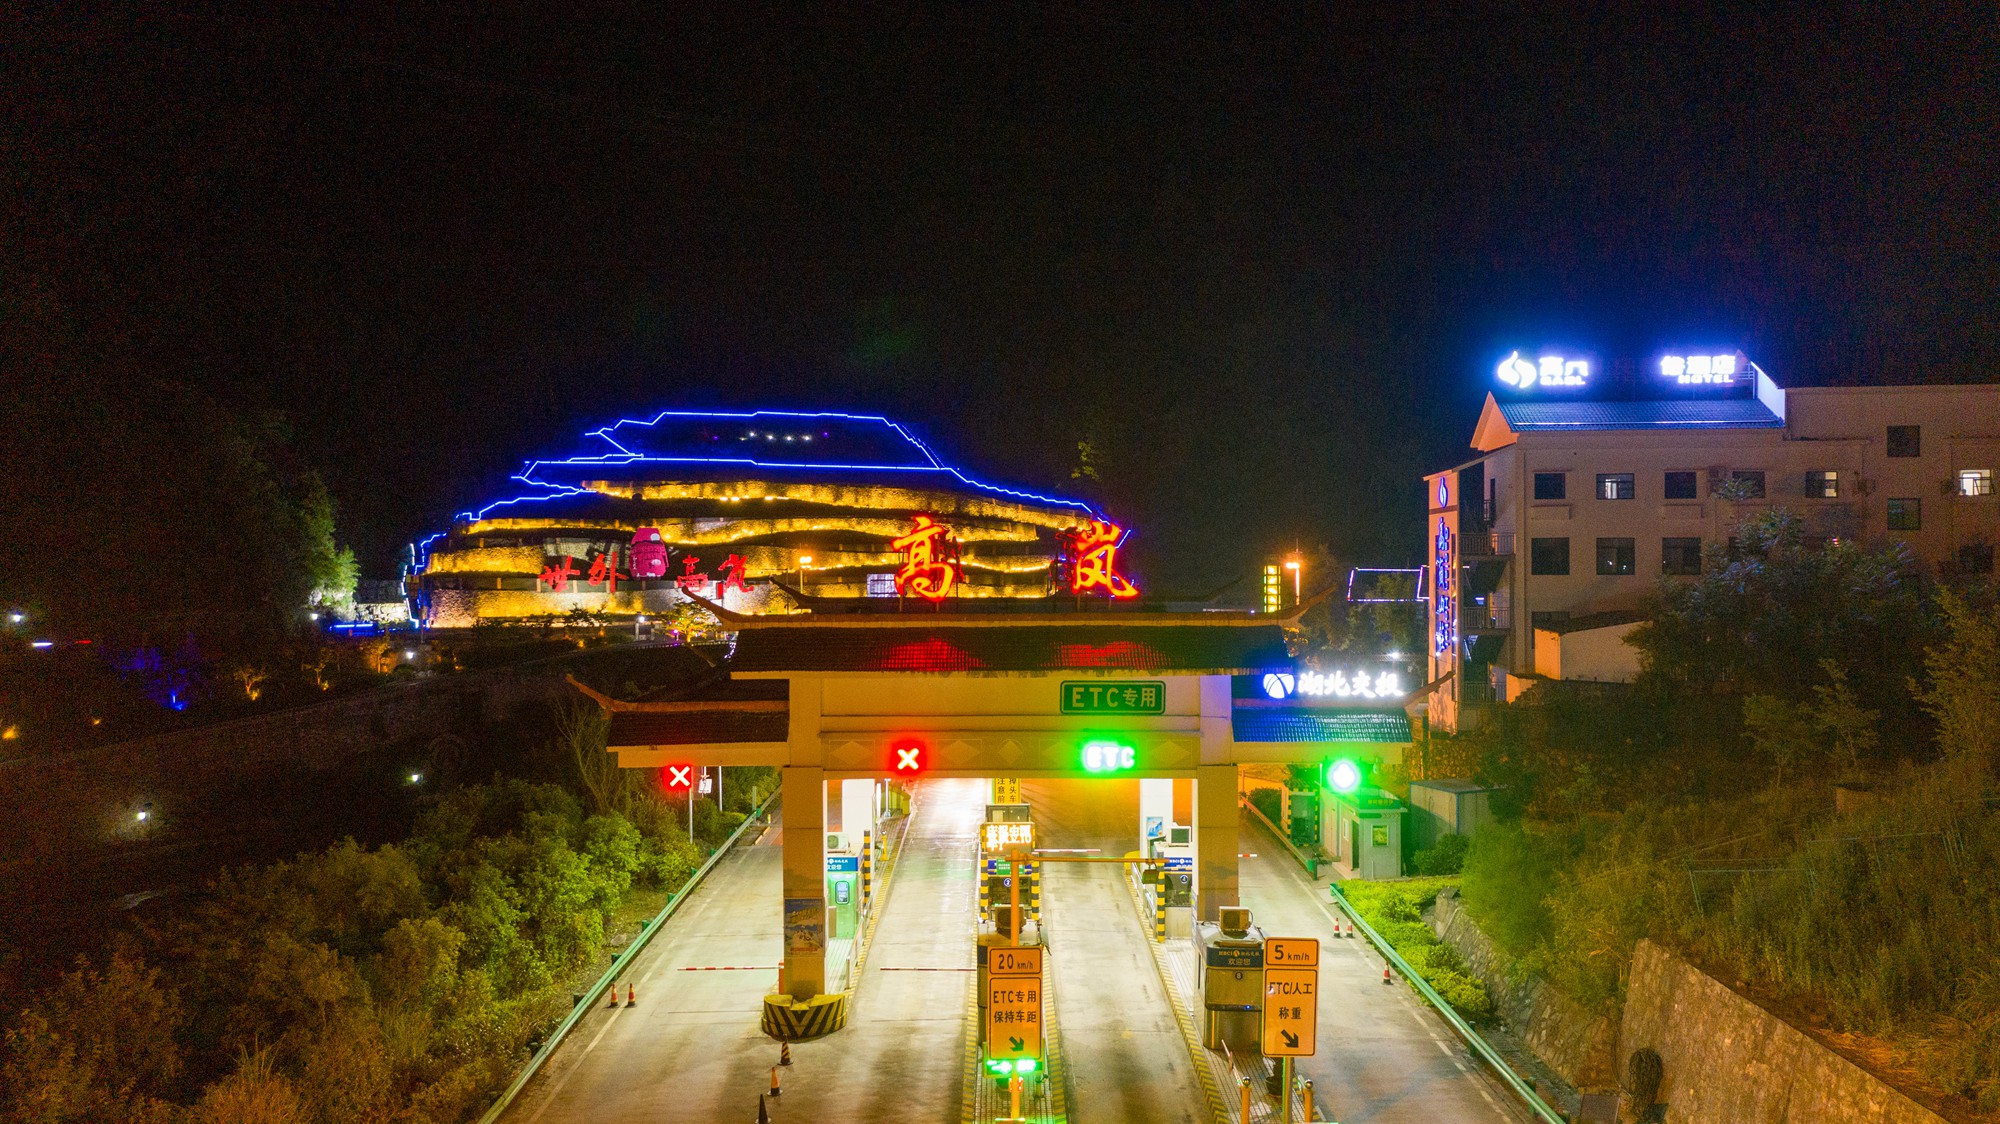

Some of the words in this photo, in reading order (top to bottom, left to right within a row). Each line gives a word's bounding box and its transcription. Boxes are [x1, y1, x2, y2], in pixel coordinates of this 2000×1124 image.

[1678, 374, 1734, 384] HOTEL
[1298, 670, 1405, 699] 湖北交投
[1072, 687, 1156, 708] ETC专用
[1084, 743, 1136, 770] ETC
[998, 953, 1015, 970] 20
[1016, 960, 1034, 971] km/h
[1274, 944, 1285, 961] 5
[1287, 951, 1310, 962] km/h
[993, 990, 1037, 1004] ETC专用
[993, 1010, 1037, 1024] 保持车距
[1278, 1006, 1302, 1020] 称重
